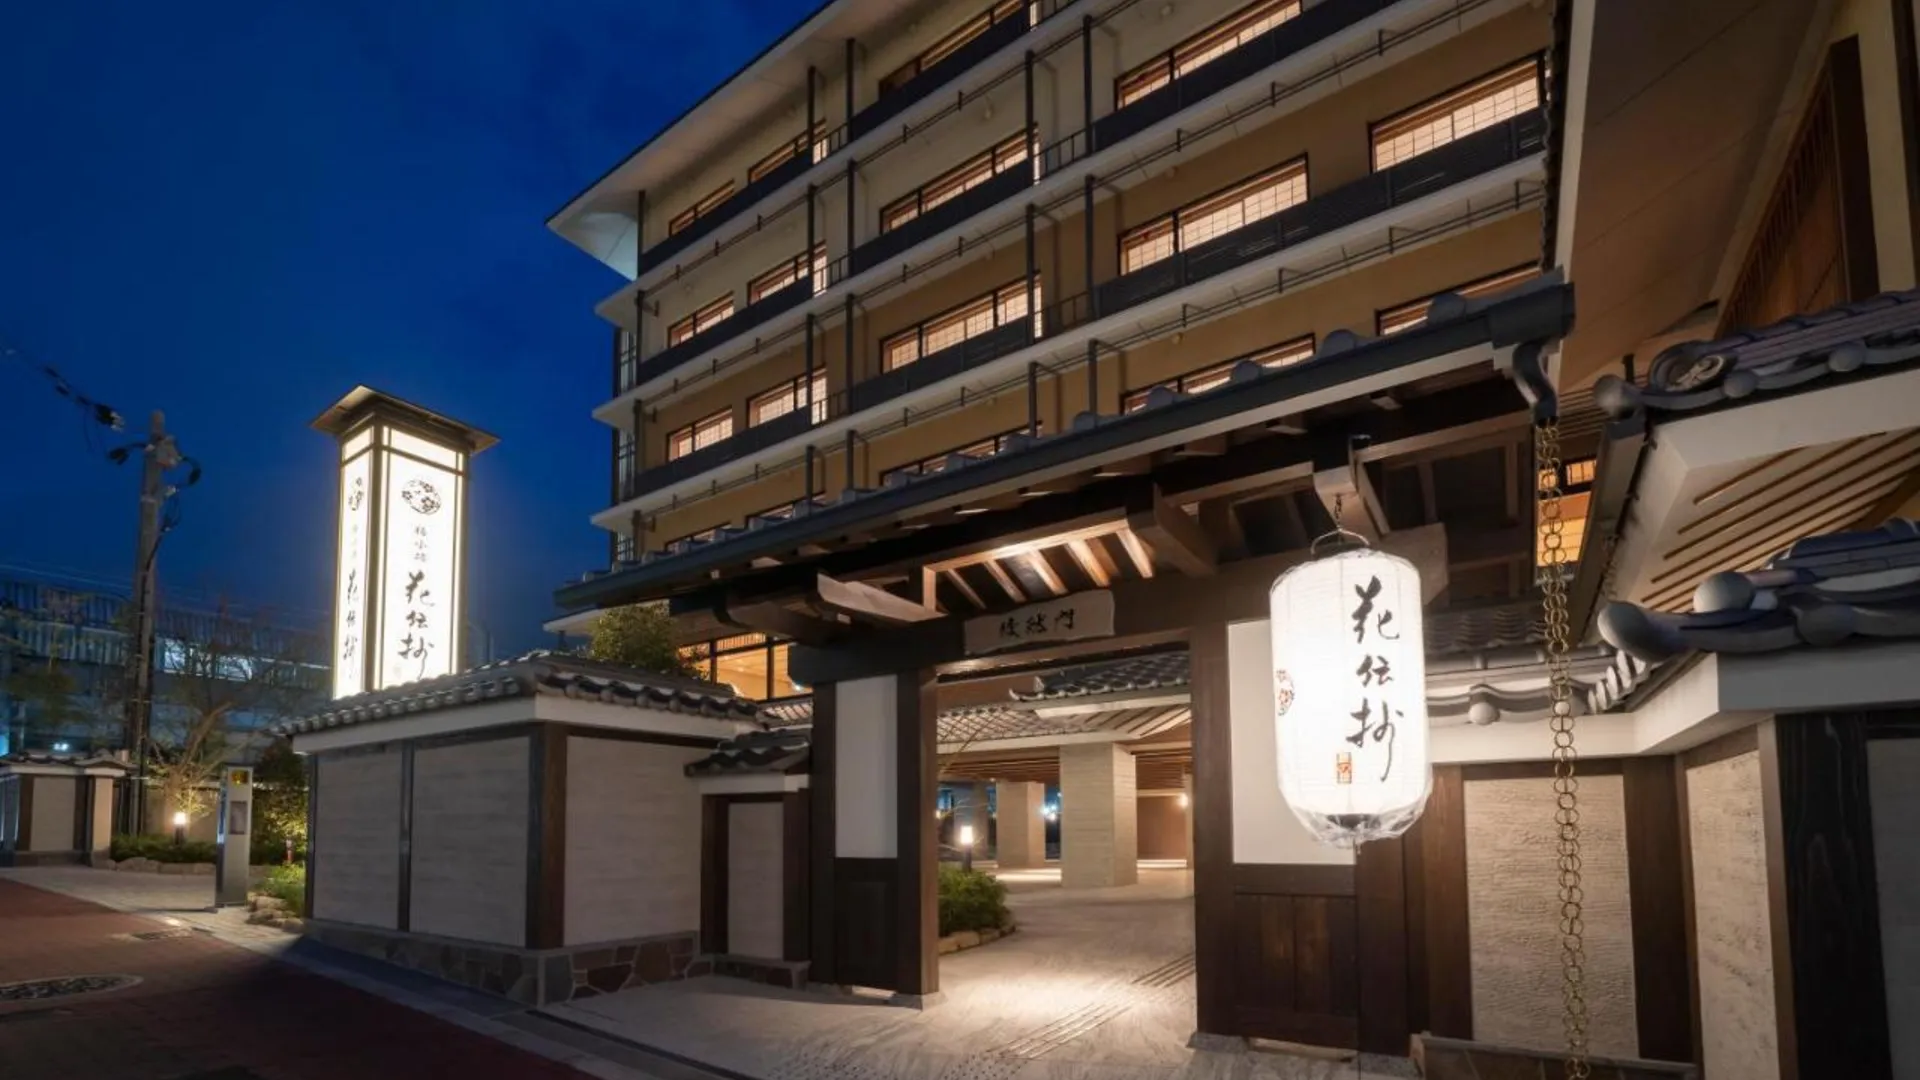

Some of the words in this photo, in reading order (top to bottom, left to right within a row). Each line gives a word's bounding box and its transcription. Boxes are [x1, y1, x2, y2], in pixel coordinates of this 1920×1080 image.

[397, 569, 435, 680] 花伝抄
[1345, 575, 1404, 782] 花伝抄
